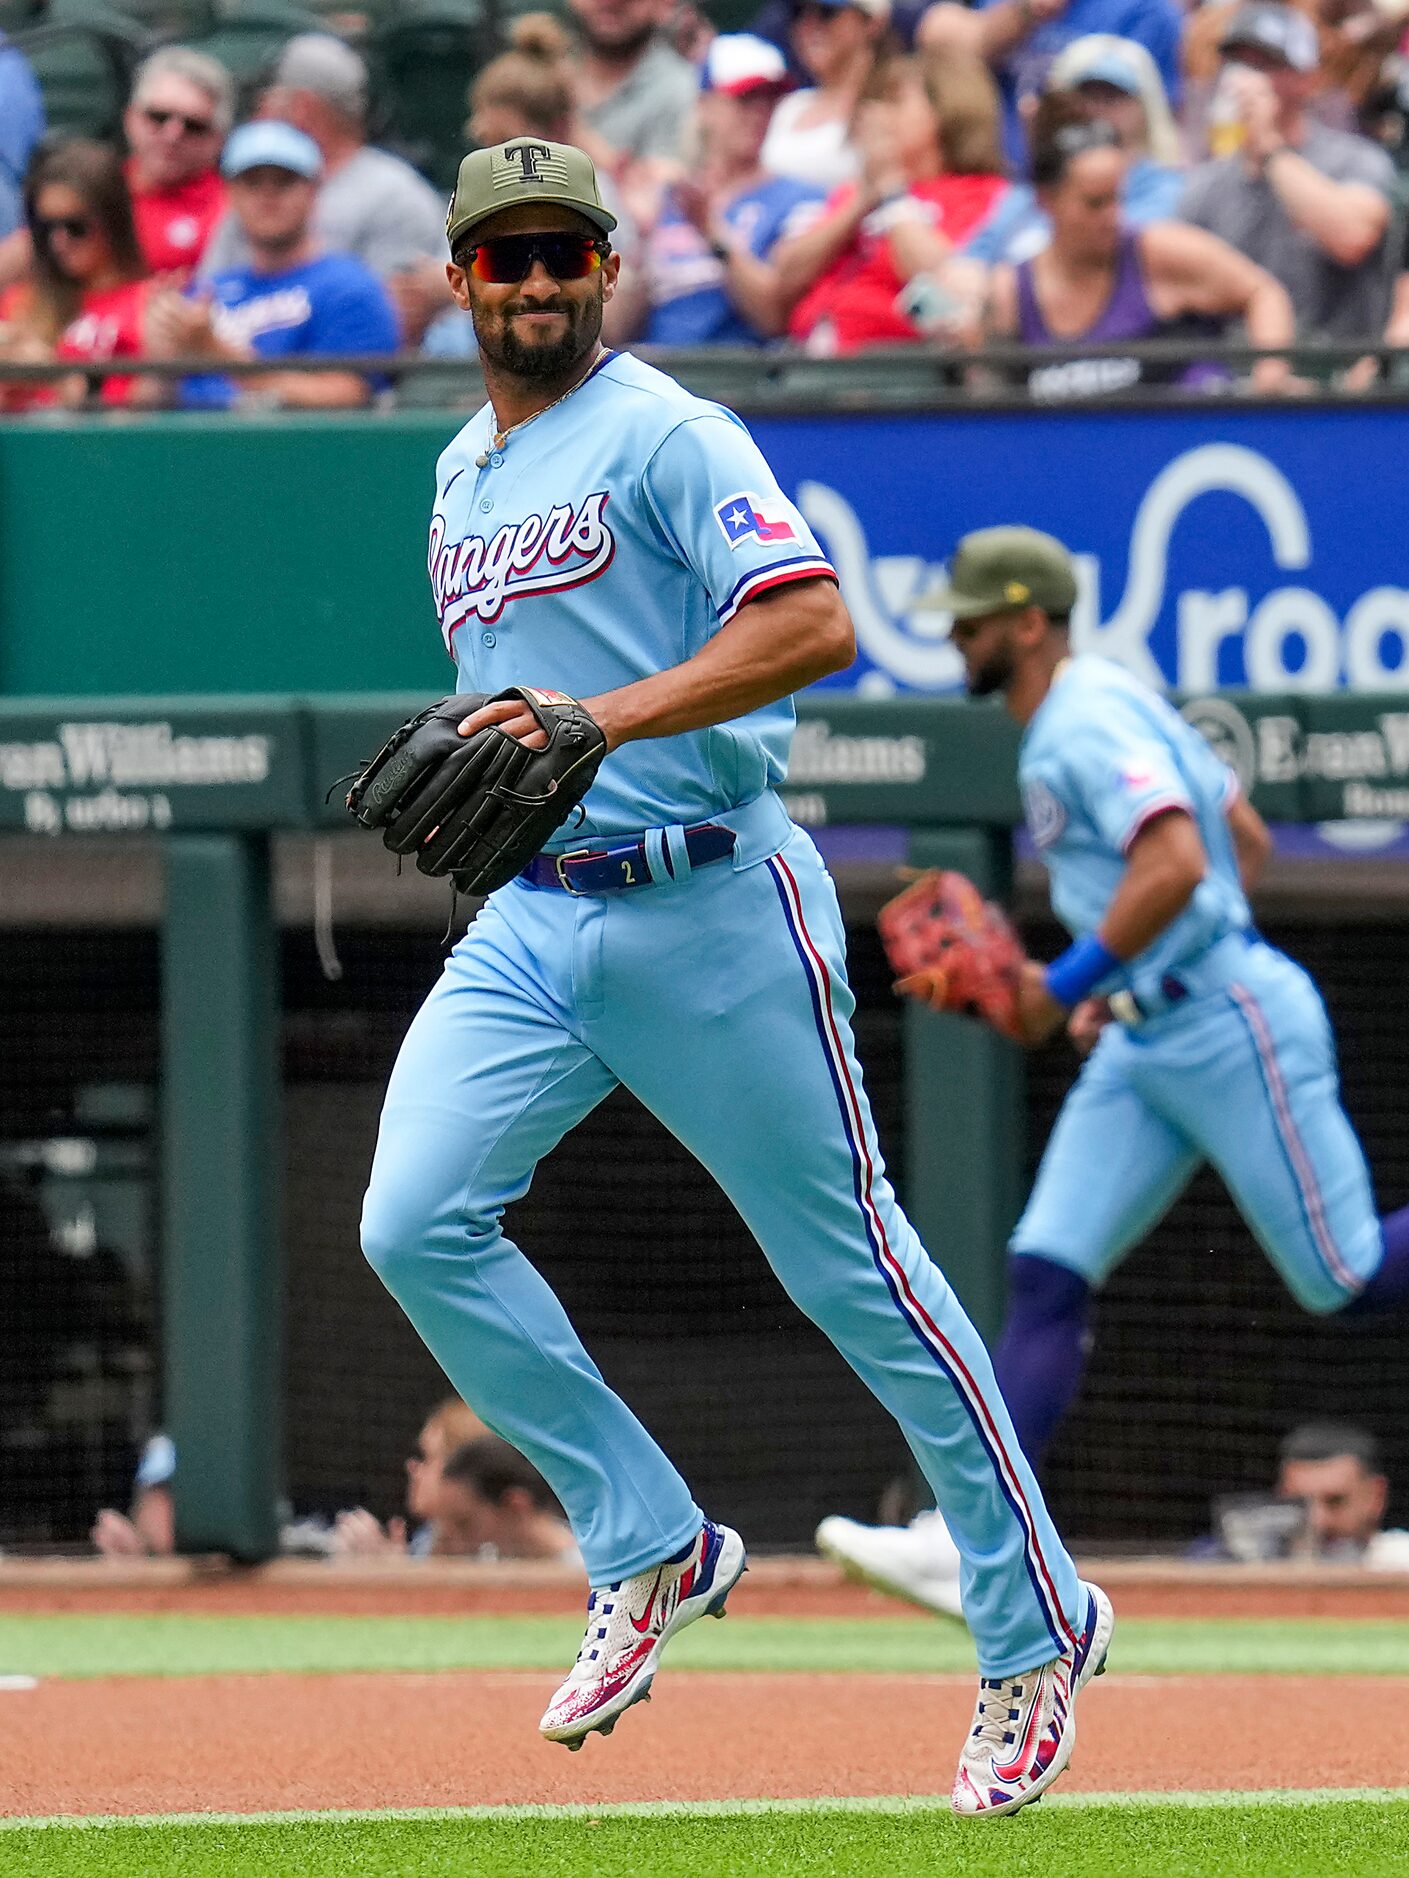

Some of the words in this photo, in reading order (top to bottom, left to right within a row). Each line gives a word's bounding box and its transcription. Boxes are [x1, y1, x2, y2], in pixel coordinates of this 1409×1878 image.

[504, 144, 551, 184] T
[428, 490, 616, 655] Rangers
[621, 860, 636, 884] 2
